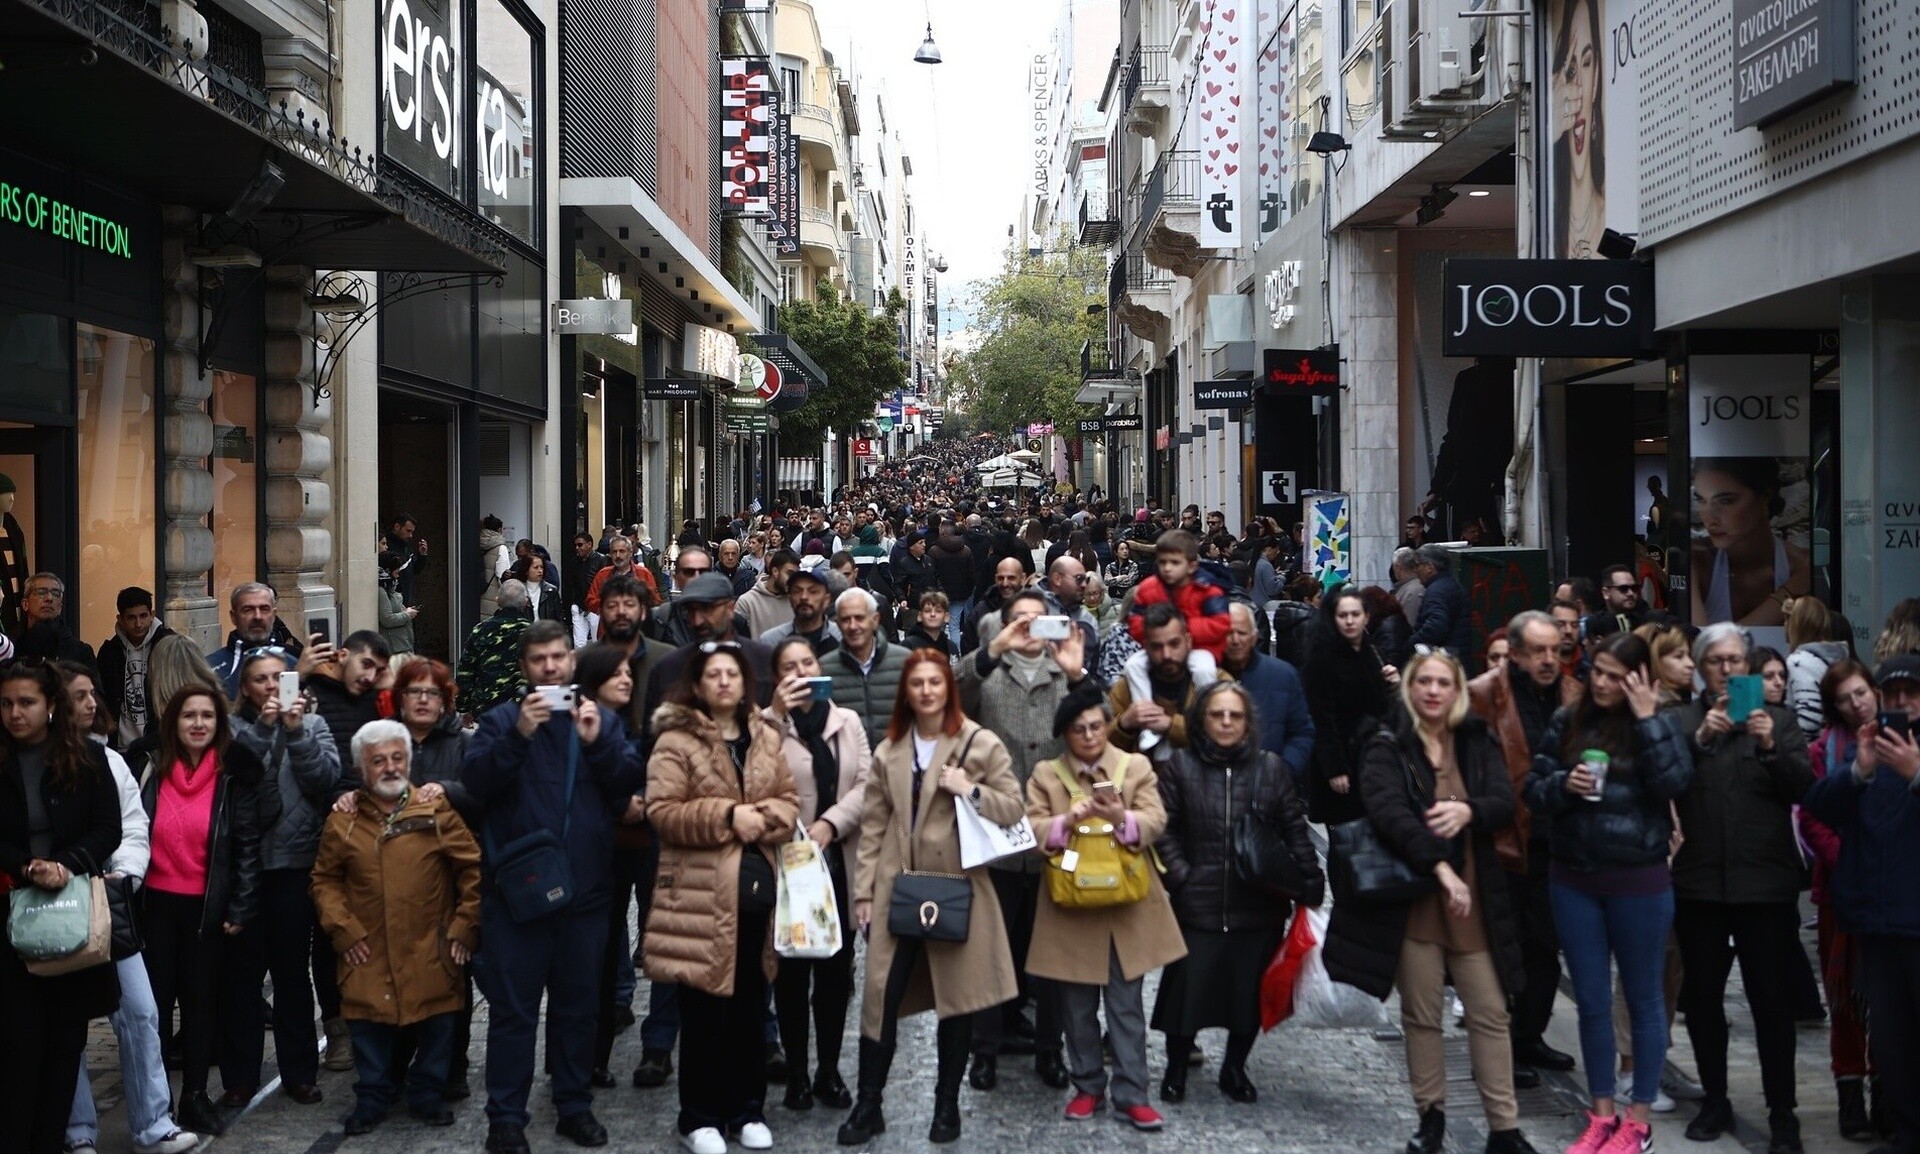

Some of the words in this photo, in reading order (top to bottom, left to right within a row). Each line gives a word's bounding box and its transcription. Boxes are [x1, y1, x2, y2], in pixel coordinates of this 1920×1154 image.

[1739, 27, 1818, 103] ΣΑΚΕΛΛΑΡΗ
[1034, 54, 1048, 132] SPENCER
[729, 69, 762, 205] POP-AIR
[1034, 150, 1049, 199] ARKS
[25, 192, 48, 230] OF
[52, 200, 131, 258] BENETTON.
[1453, 284, 1632, 337] JOOLS
[1198, 388, 1249, 399] sofronas
[1701, 395, 1800, 426] JOOLS
[1081, 422, 1100, 431] BSB
